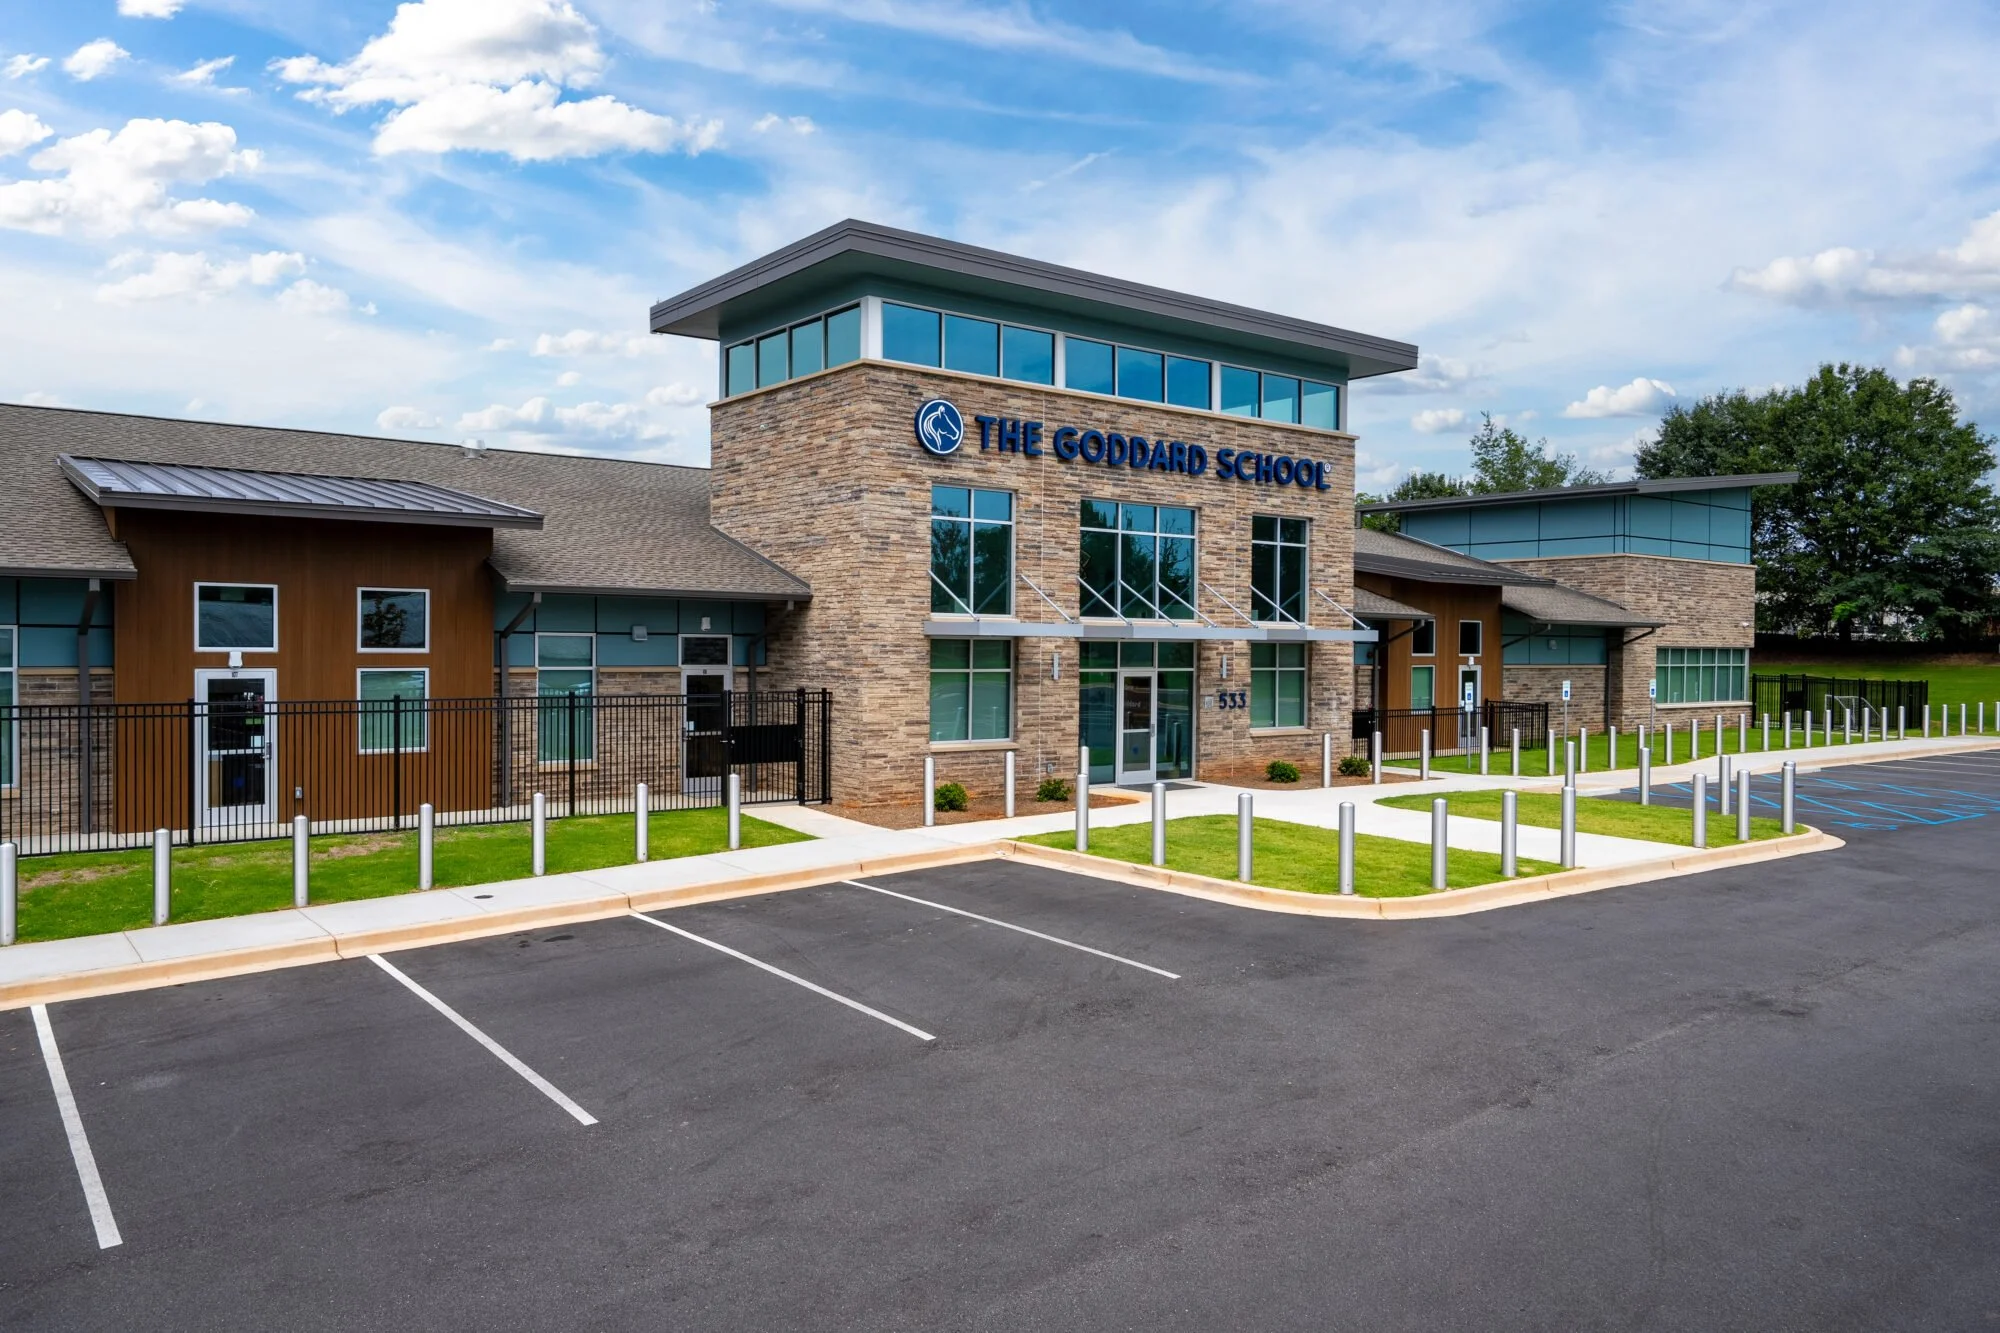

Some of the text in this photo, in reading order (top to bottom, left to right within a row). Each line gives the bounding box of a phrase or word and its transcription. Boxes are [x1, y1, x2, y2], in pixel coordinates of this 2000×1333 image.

[975, 415, 1043, 455] THE
[1053, 426, 1207, 476] GODDARD
[1219, 692, 1246, 709] 533
